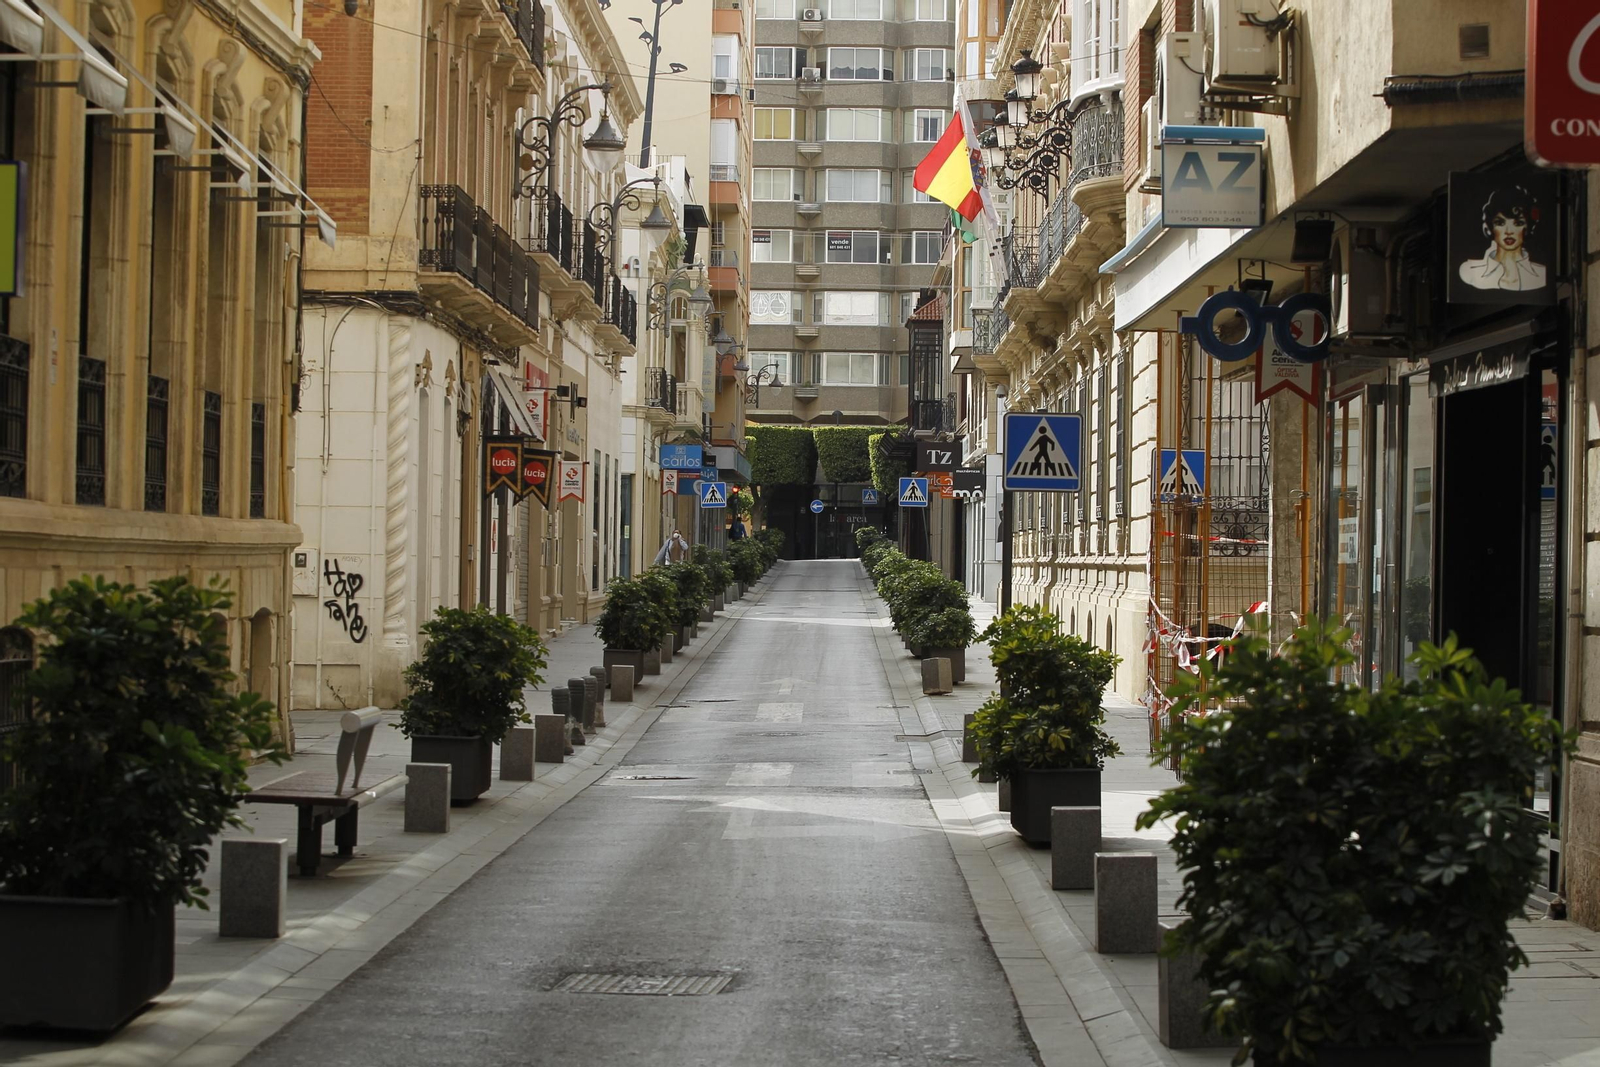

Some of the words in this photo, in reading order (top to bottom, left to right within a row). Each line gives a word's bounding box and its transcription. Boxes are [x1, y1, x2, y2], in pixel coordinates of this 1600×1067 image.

[1169, 151, 1255, 193] AZ
[492, 457, 516, 467] lucia
[662, 454, 701, 467] carlos
[524, 468, 545, 478] lucia
